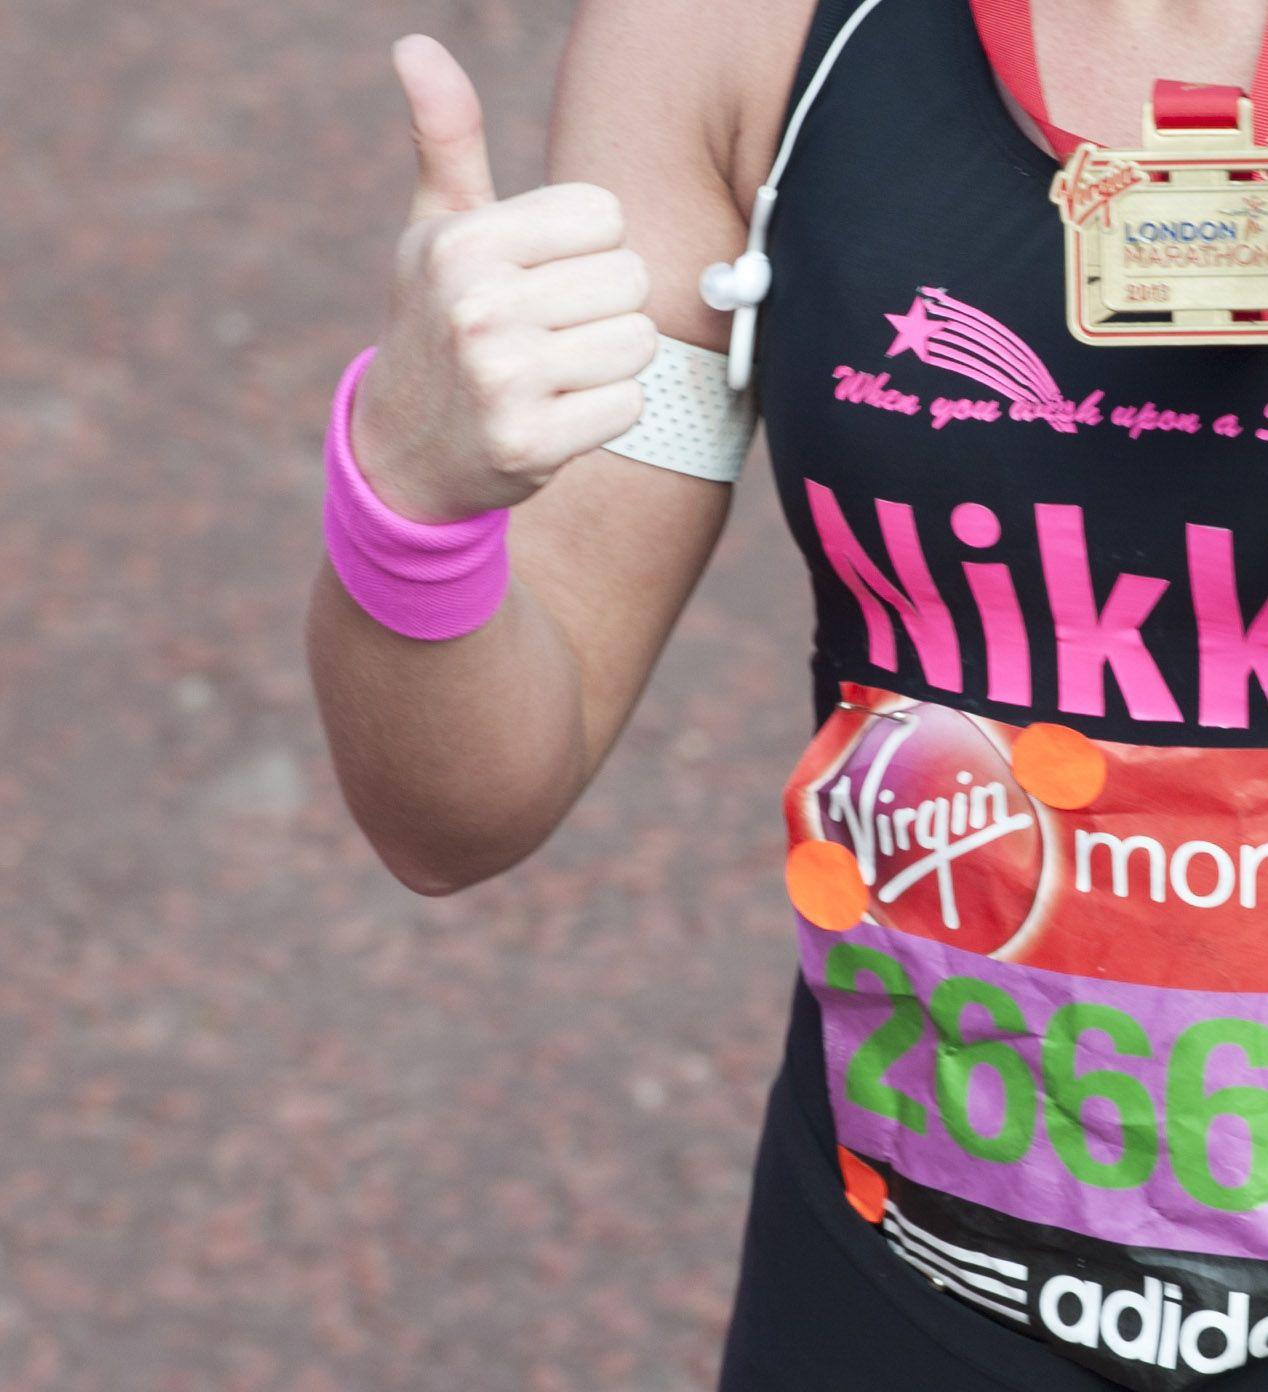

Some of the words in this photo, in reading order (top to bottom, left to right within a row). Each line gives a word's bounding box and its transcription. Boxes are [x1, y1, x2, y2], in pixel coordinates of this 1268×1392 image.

[1124, 220, 1238, 245] LONDON
[832, 364, 922, 416] When
[929, 396, 1003, 431] you
[1110, 401, 1203, 440] upon
[1212, 413, 1244, 439] a
[829, 712, 1034, 930] Virgin
